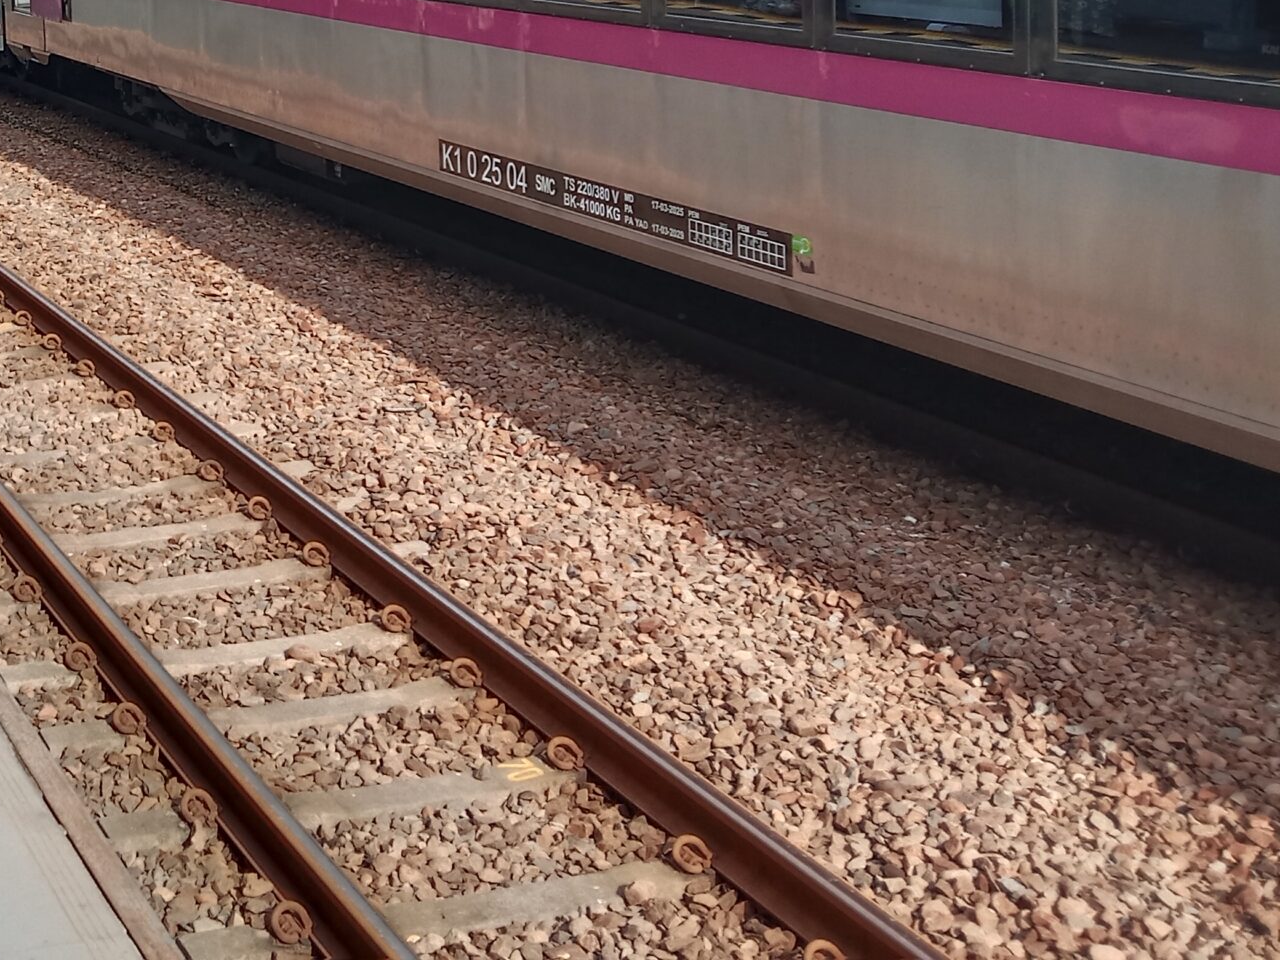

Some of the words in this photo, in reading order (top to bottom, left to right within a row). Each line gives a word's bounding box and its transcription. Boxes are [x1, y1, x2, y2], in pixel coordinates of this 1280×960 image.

[442, 143, 461, 174] K1
[467, 151, 477, 178] 0
[481, 155, 502, 186] 25
[506, 162, 527, 193] 04
[535, 174, 556, 196] SMC
[563, 176, 576, 191] TS
[577, 181, 610, 202] 220/380
[611, 190, 619, 204] V
[563, 193, 605, 217] BK-41000
[606, 205, 621, 221] KG
[624, 204, 634, 214] PA
[624, 215, 634, 226] PA
